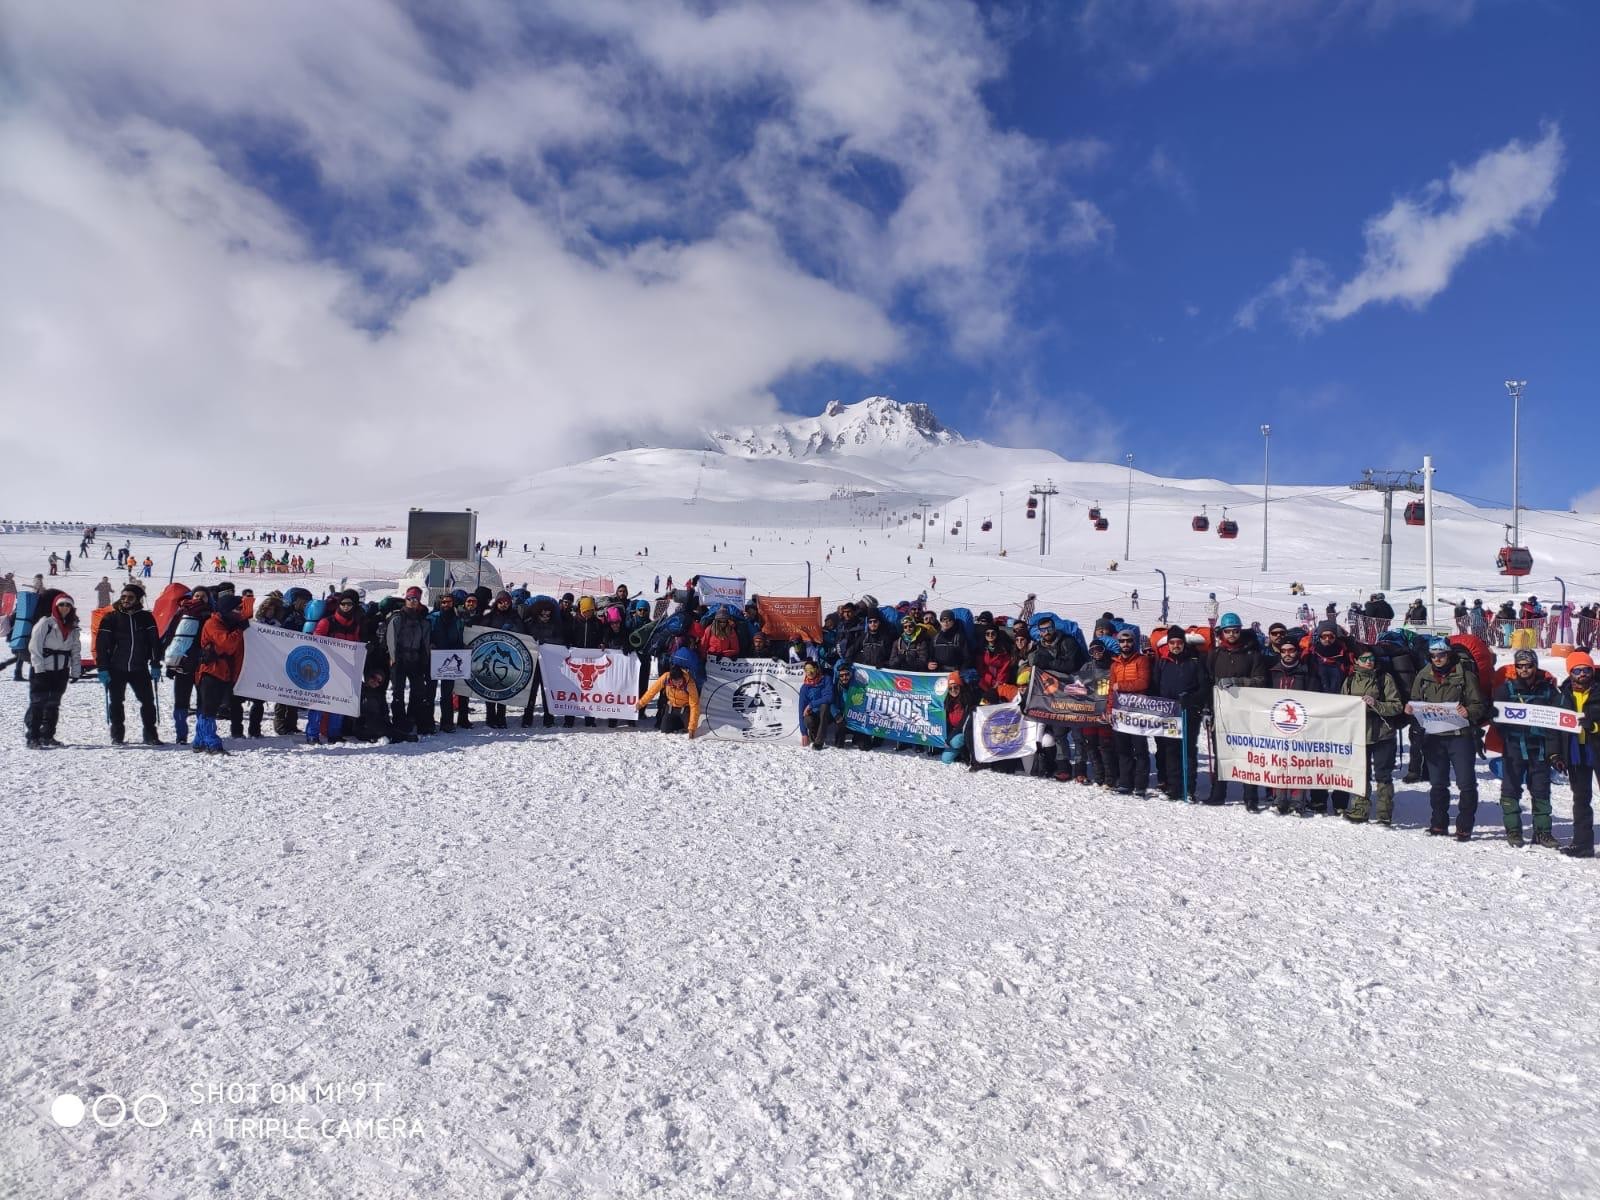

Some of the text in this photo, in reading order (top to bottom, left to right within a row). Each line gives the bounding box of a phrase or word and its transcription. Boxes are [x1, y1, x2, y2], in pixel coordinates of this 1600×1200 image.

[865, 692, 932, 721] TÜDOST
[1125, 715, 1177, 730] BOULDER
[1226, 734, 1353, 755] ONDOKUZMAYIS ÜNİVERSİTESİ
[1247, 751, 1334, 770] Dağ. Kış Sporları
[1231, 766, 1353, 788] Arama Kurtarma Kulübü
